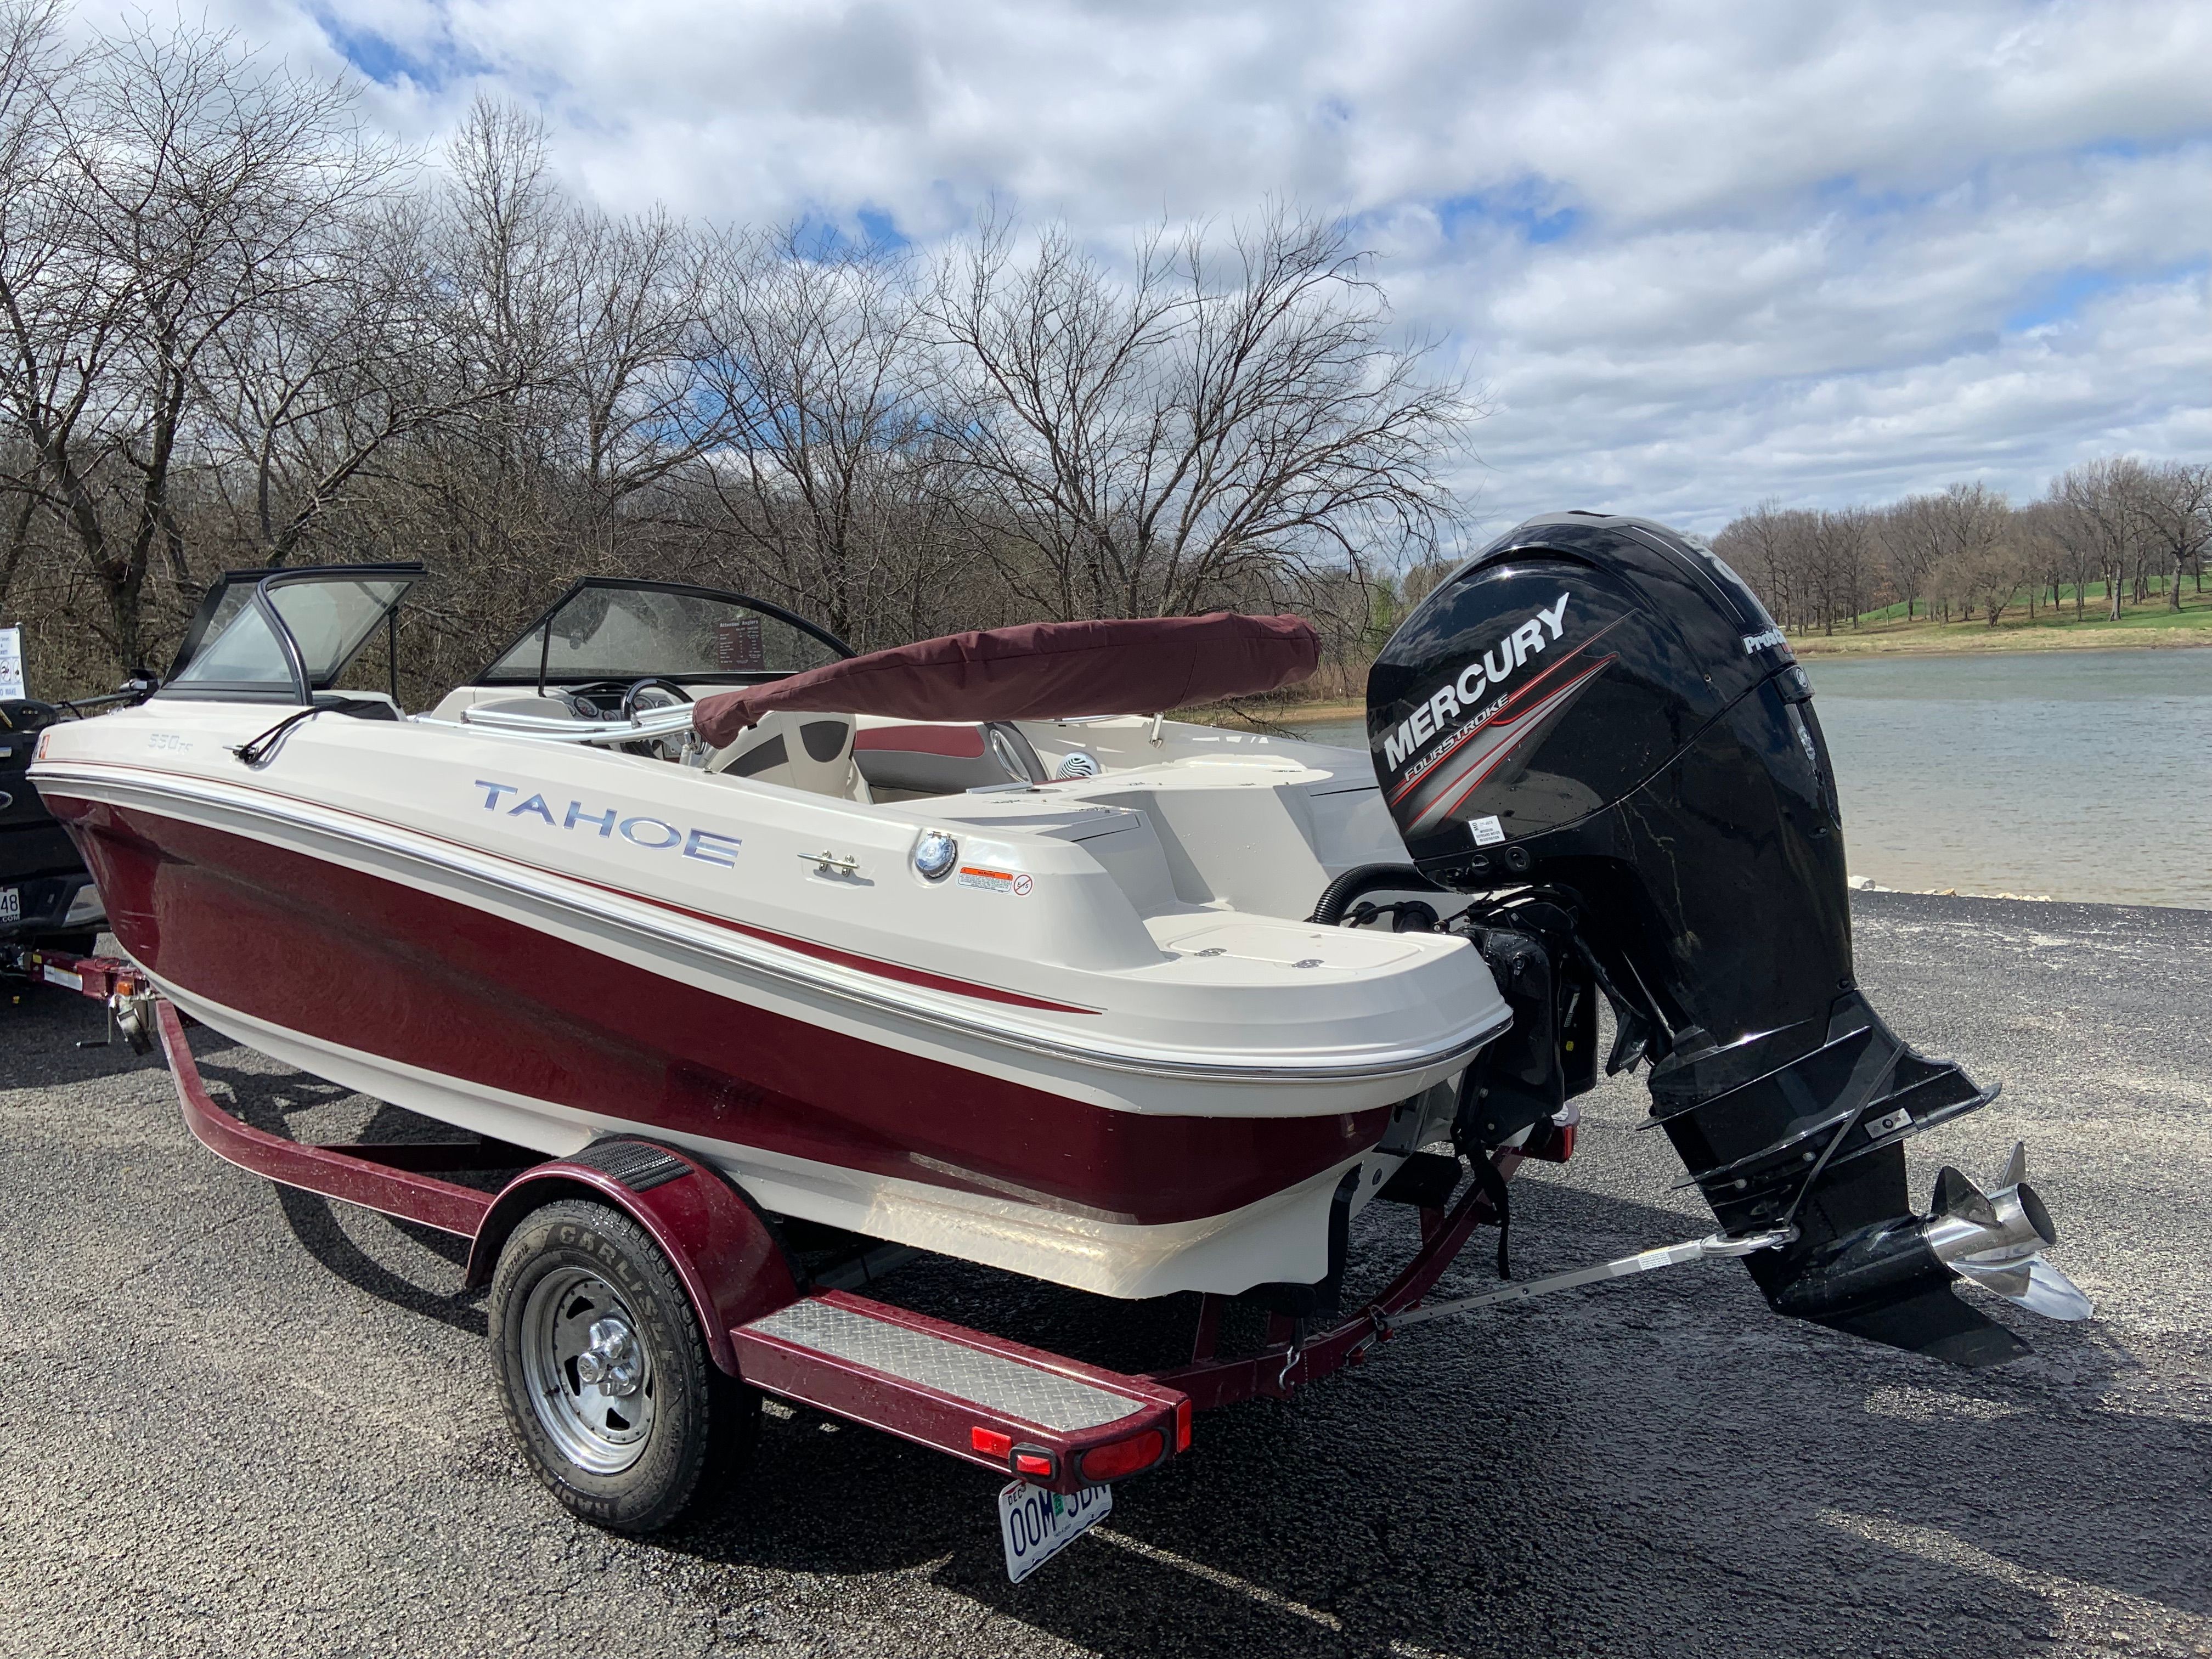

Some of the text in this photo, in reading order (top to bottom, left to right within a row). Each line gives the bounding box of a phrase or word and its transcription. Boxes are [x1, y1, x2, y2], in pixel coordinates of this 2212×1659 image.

[1384, 591, 1570, 772] MERCURY
[1404, 692, 1510, 782] FOURSTROKE
[474, 779, 742, 869] TAHOE
[560, 1225, 674, 1364] CARLISLE
